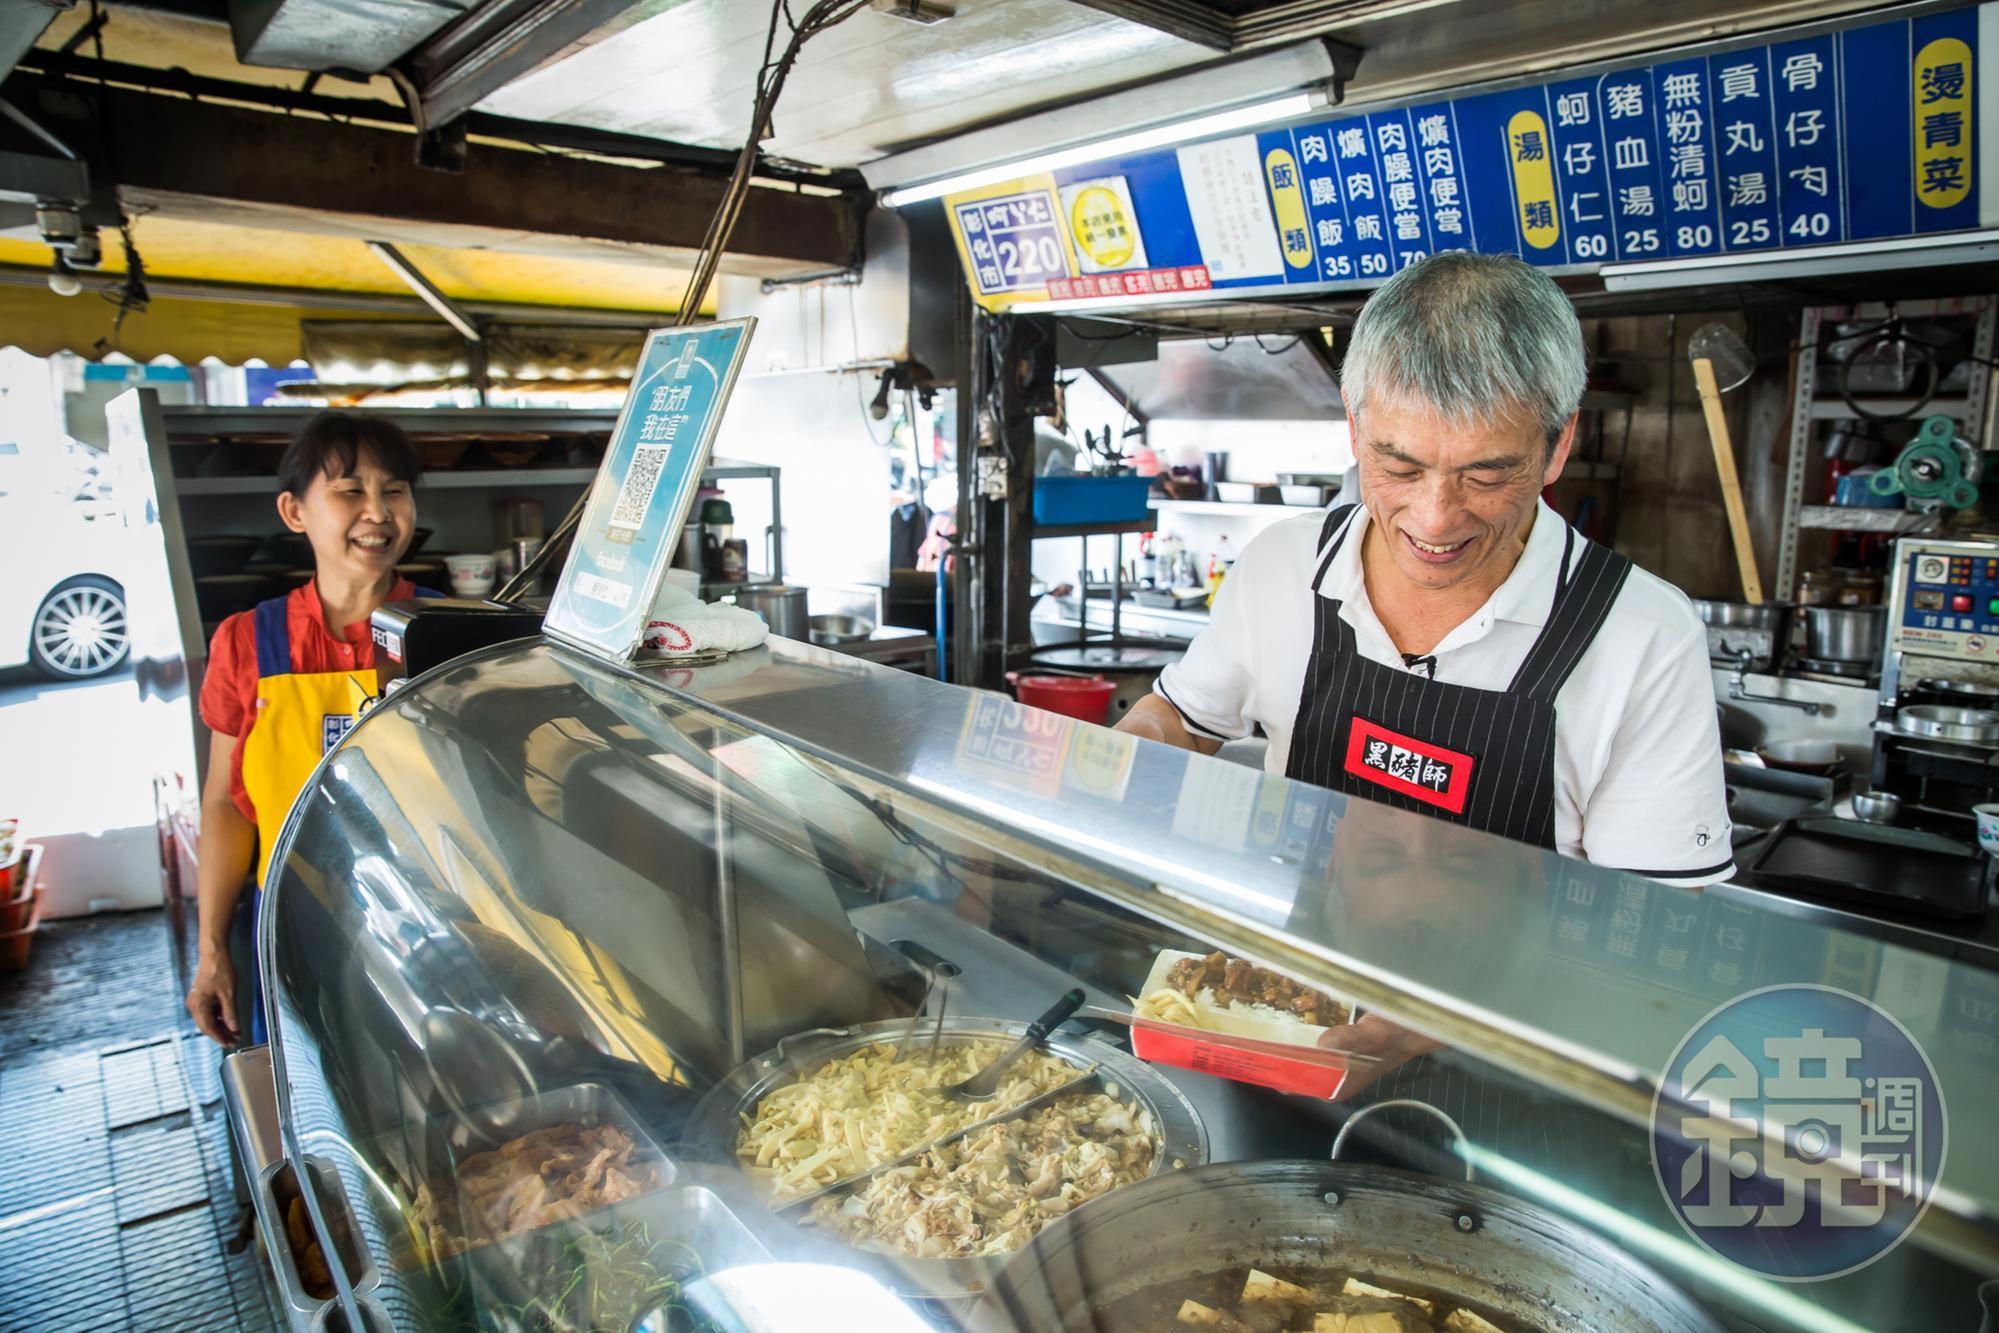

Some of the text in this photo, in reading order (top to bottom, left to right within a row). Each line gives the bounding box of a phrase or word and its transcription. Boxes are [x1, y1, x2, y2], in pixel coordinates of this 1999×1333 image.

[1417, 114, 1463, 234] 爌肉便當
[1512, 130, 1555, 231] 湯類
[1556, 92, 1608, 258] 蚵仔仁 60
[1606, 82, 1660, 253] 豬血湯 25
[1662, 72, 1713, 249] 無粉清蚵 80
[1718, 63, 1771, 245] 貢丸湯 25
[1920, 62, 1965, 194] 燙青菜
[999, 235, 1062, 278] 220
[1270, 162, 1308, 253] 飯類
[1336, 127, 1388, 274] 爌肉飯 50
[1789, 212, 1831, 239] 40
[1324, 255, 1351, 277] 35
